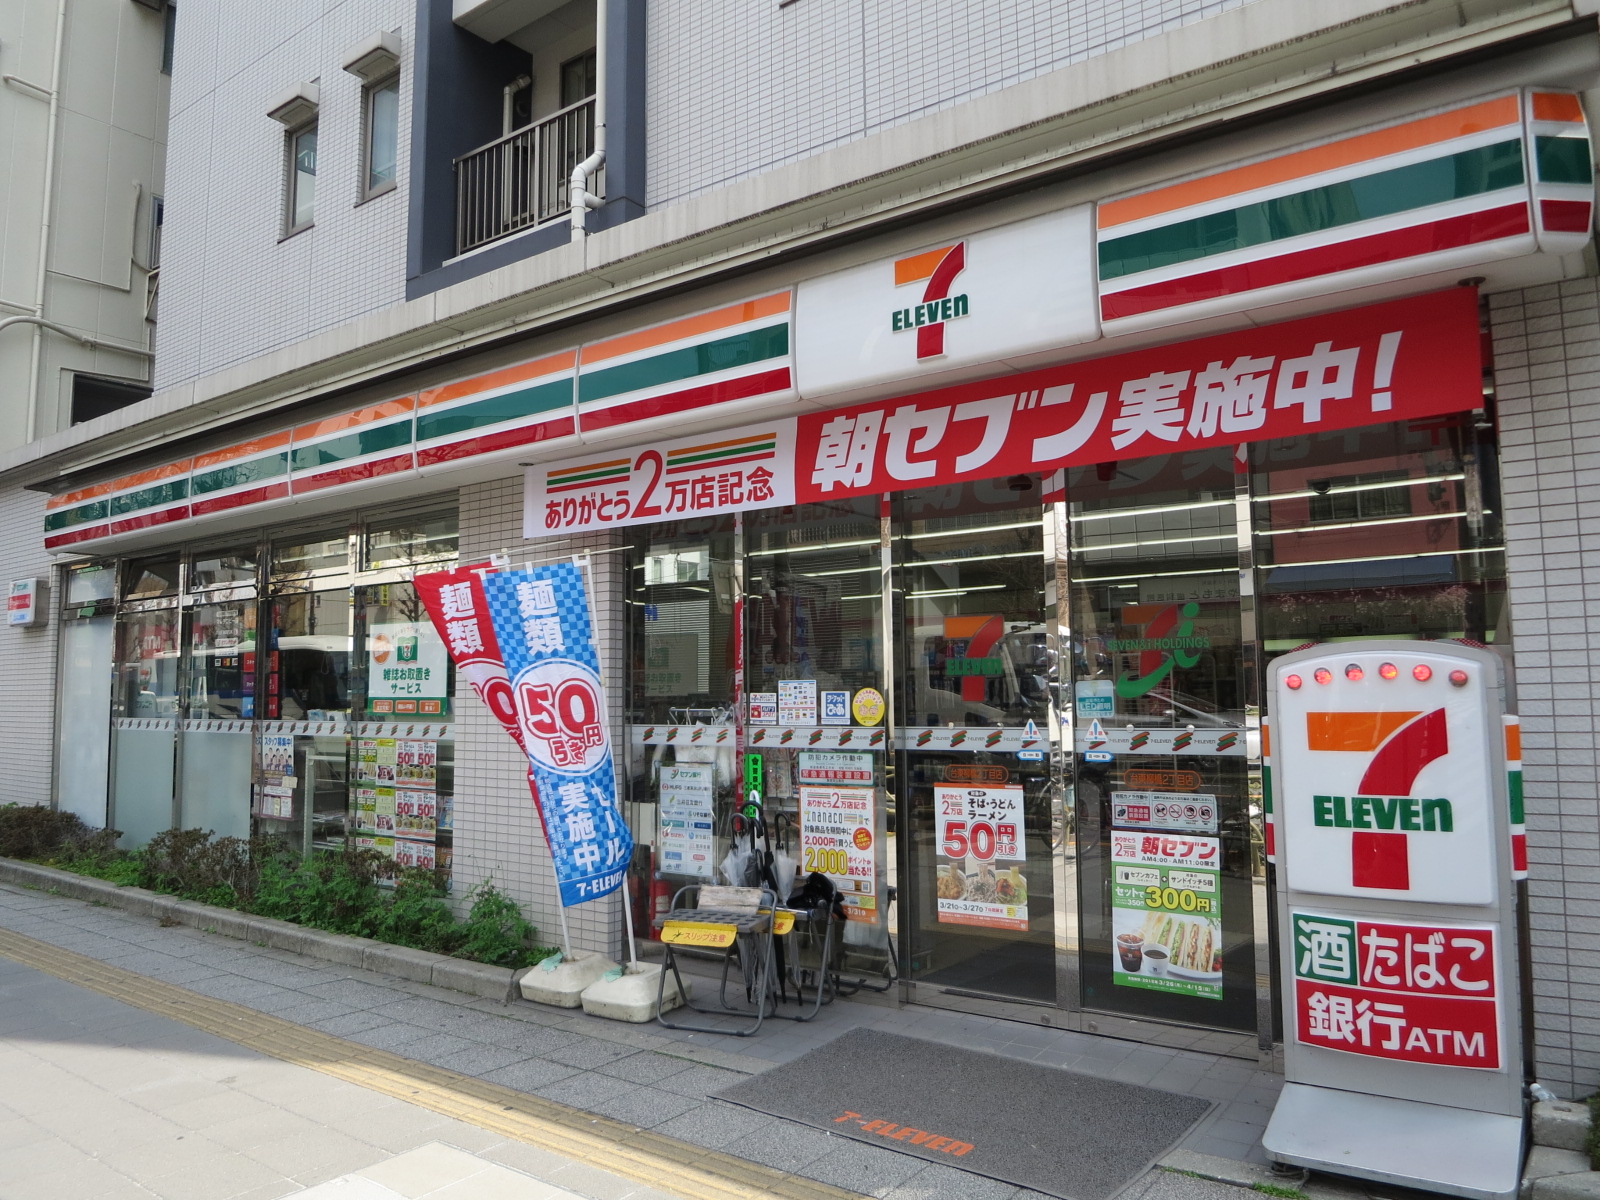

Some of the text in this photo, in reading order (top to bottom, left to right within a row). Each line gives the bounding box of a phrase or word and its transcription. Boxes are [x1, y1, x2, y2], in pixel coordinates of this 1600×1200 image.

[811, 331, 1403, 492] 朝セブン実施中!
[545, 450, 775, 529] ありがとう2万店記念
[517, 578, 566, 656] 麺類
[1154, 636, 1210, 649] HOLDINGS
[391, 683, 422, 694] サービス
[808, 753, 864, 762] 防犯カメラ作動中
[807, 792, 867, 810] ありがとう2万店記念
[968, 810, 1007, 821] ラーメン
[558, 781, 602, 873] 実施中
[1141, 836, 1217, 860] 朝セブン
[1130, 872, 1159, 880] セブンカフェ
[1115, 886, 1145, 898] セットで
[1145, 886, 1211, 912] 300円
[684, 932, 727, 943] スリップ注意
[1298, 918, 1352, 980] 酒
[1360, 927, 1490, 992] たばこ
